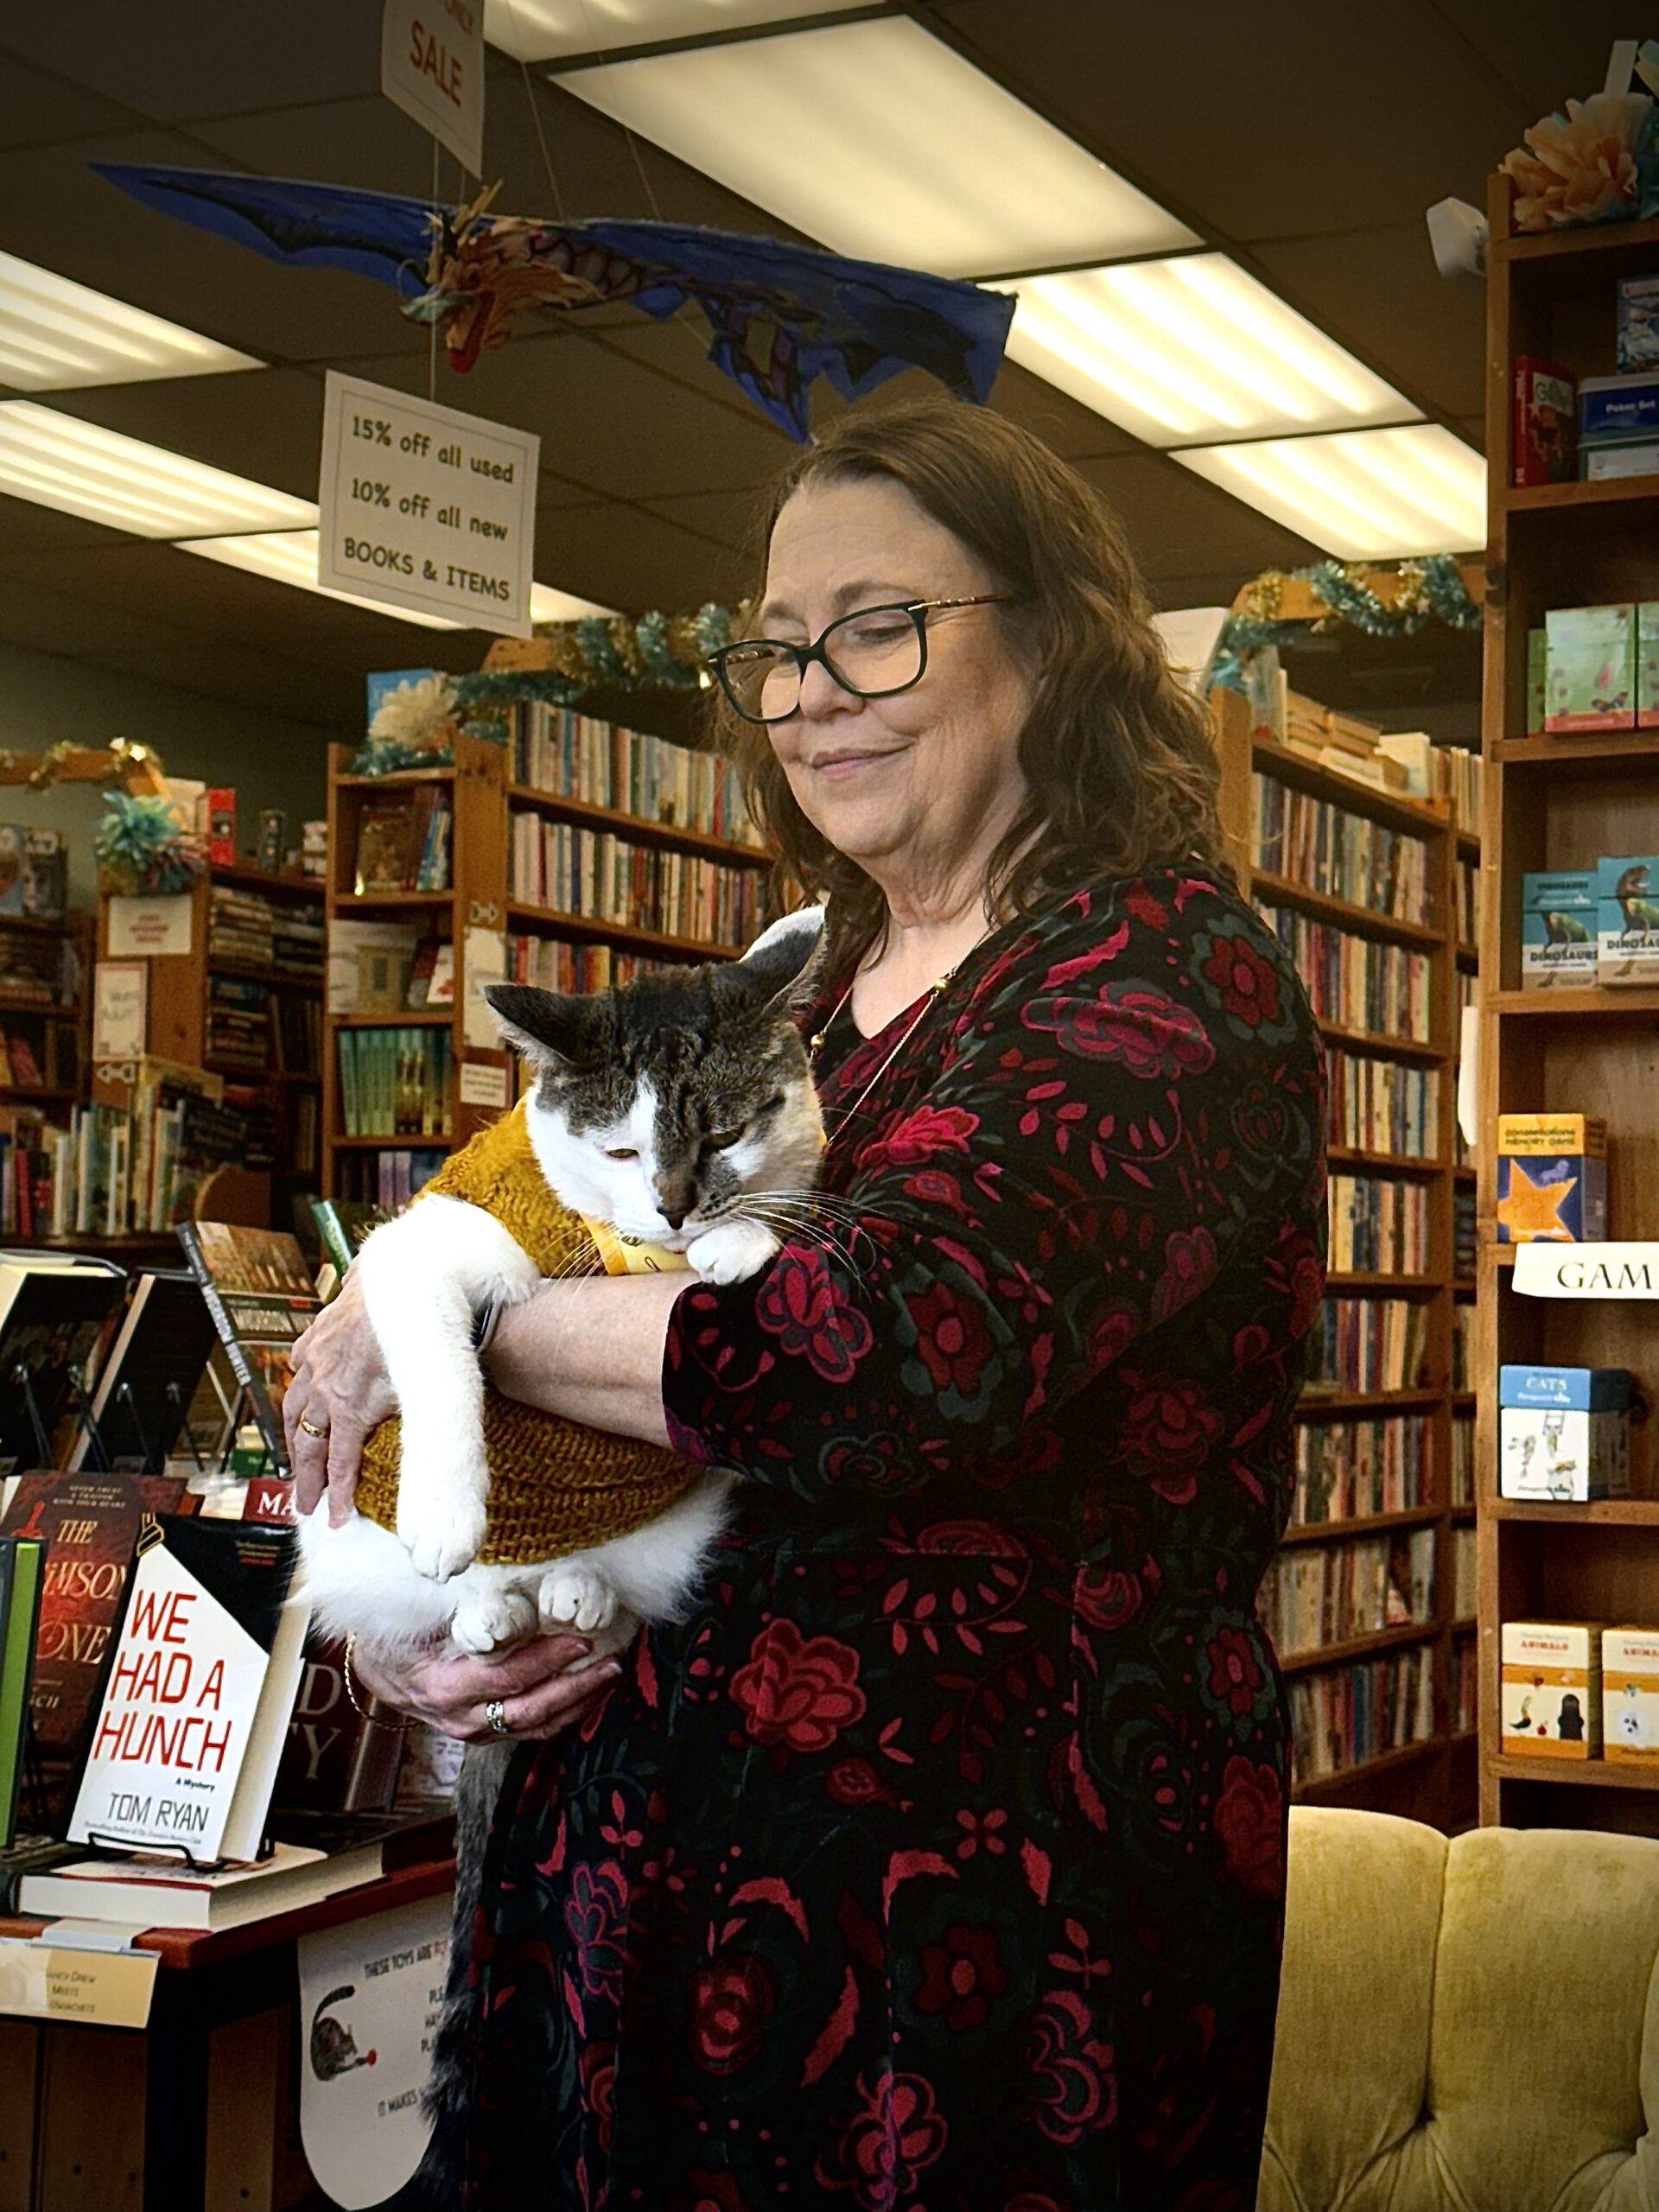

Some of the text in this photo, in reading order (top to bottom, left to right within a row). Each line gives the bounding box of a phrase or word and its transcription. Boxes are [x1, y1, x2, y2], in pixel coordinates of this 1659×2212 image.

[410, 19, 461, 107] SALE
[1605, 400, 1656, 413] Poker Set
[353, 415, 515, 484] 15% off all used
[351, 478, 508, 542] 10% off all new
[344, 537, 510, 601] BOOKS & ITEMS
[1556, 1262, 1659, 1289] GAM
[1526, 1376, 1567, 1392] CATS
[57, 1519, 99, 1544] THE
[130, 1588, 198, 1644] WE
[109, 1651, 225, 1711] HAD A
[92, 1710, 232, 1773] HUNCH
[107, 1792, 209, 1833] TOM RYAN
[183, 1778, 215, 1792] Mystery
